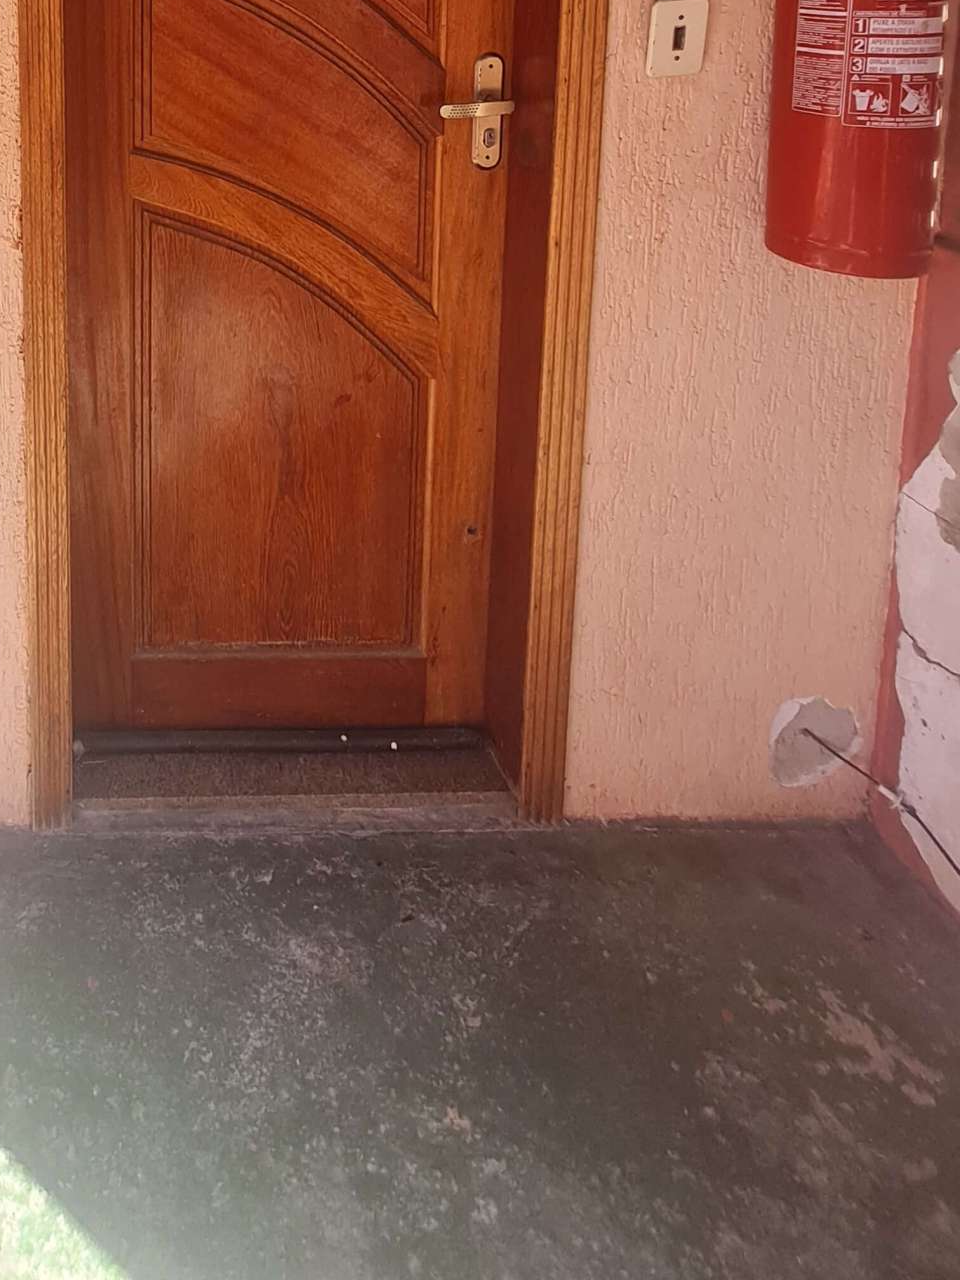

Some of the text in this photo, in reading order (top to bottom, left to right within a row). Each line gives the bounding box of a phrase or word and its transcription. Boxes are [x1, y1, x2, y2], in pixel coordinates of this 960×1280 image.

[854, 19, 864, 32] 1
[853, 39, 865, 52] 2
[851, 58, 863, 72] 3
